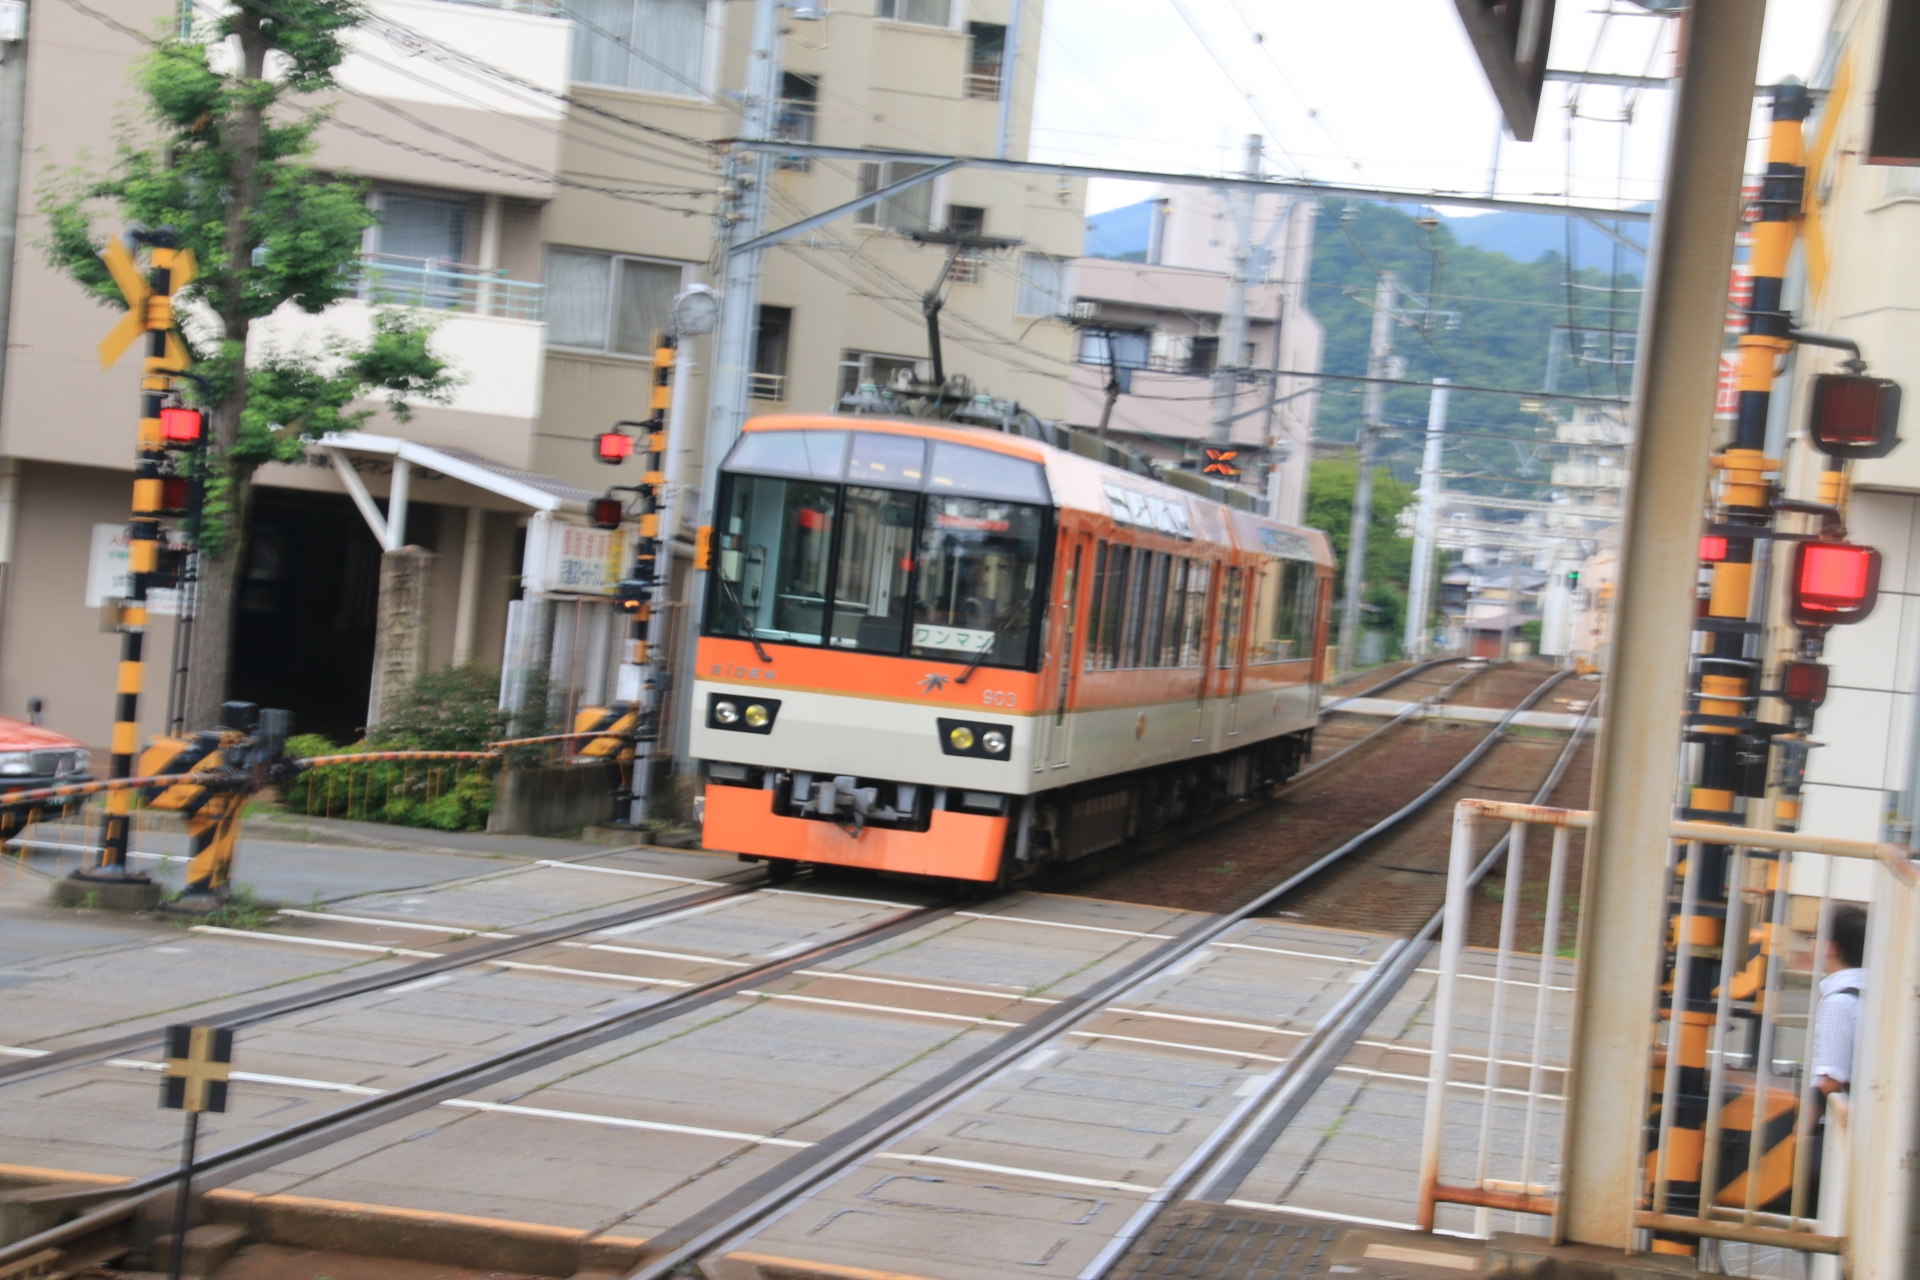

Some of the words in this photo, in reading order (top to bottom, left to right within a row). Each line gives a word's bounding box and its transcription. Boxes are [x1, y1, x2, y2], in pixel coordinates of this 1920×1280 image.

[916, 628, 991, 649] ワンマン
[982, 689, 1016, 707] 903
